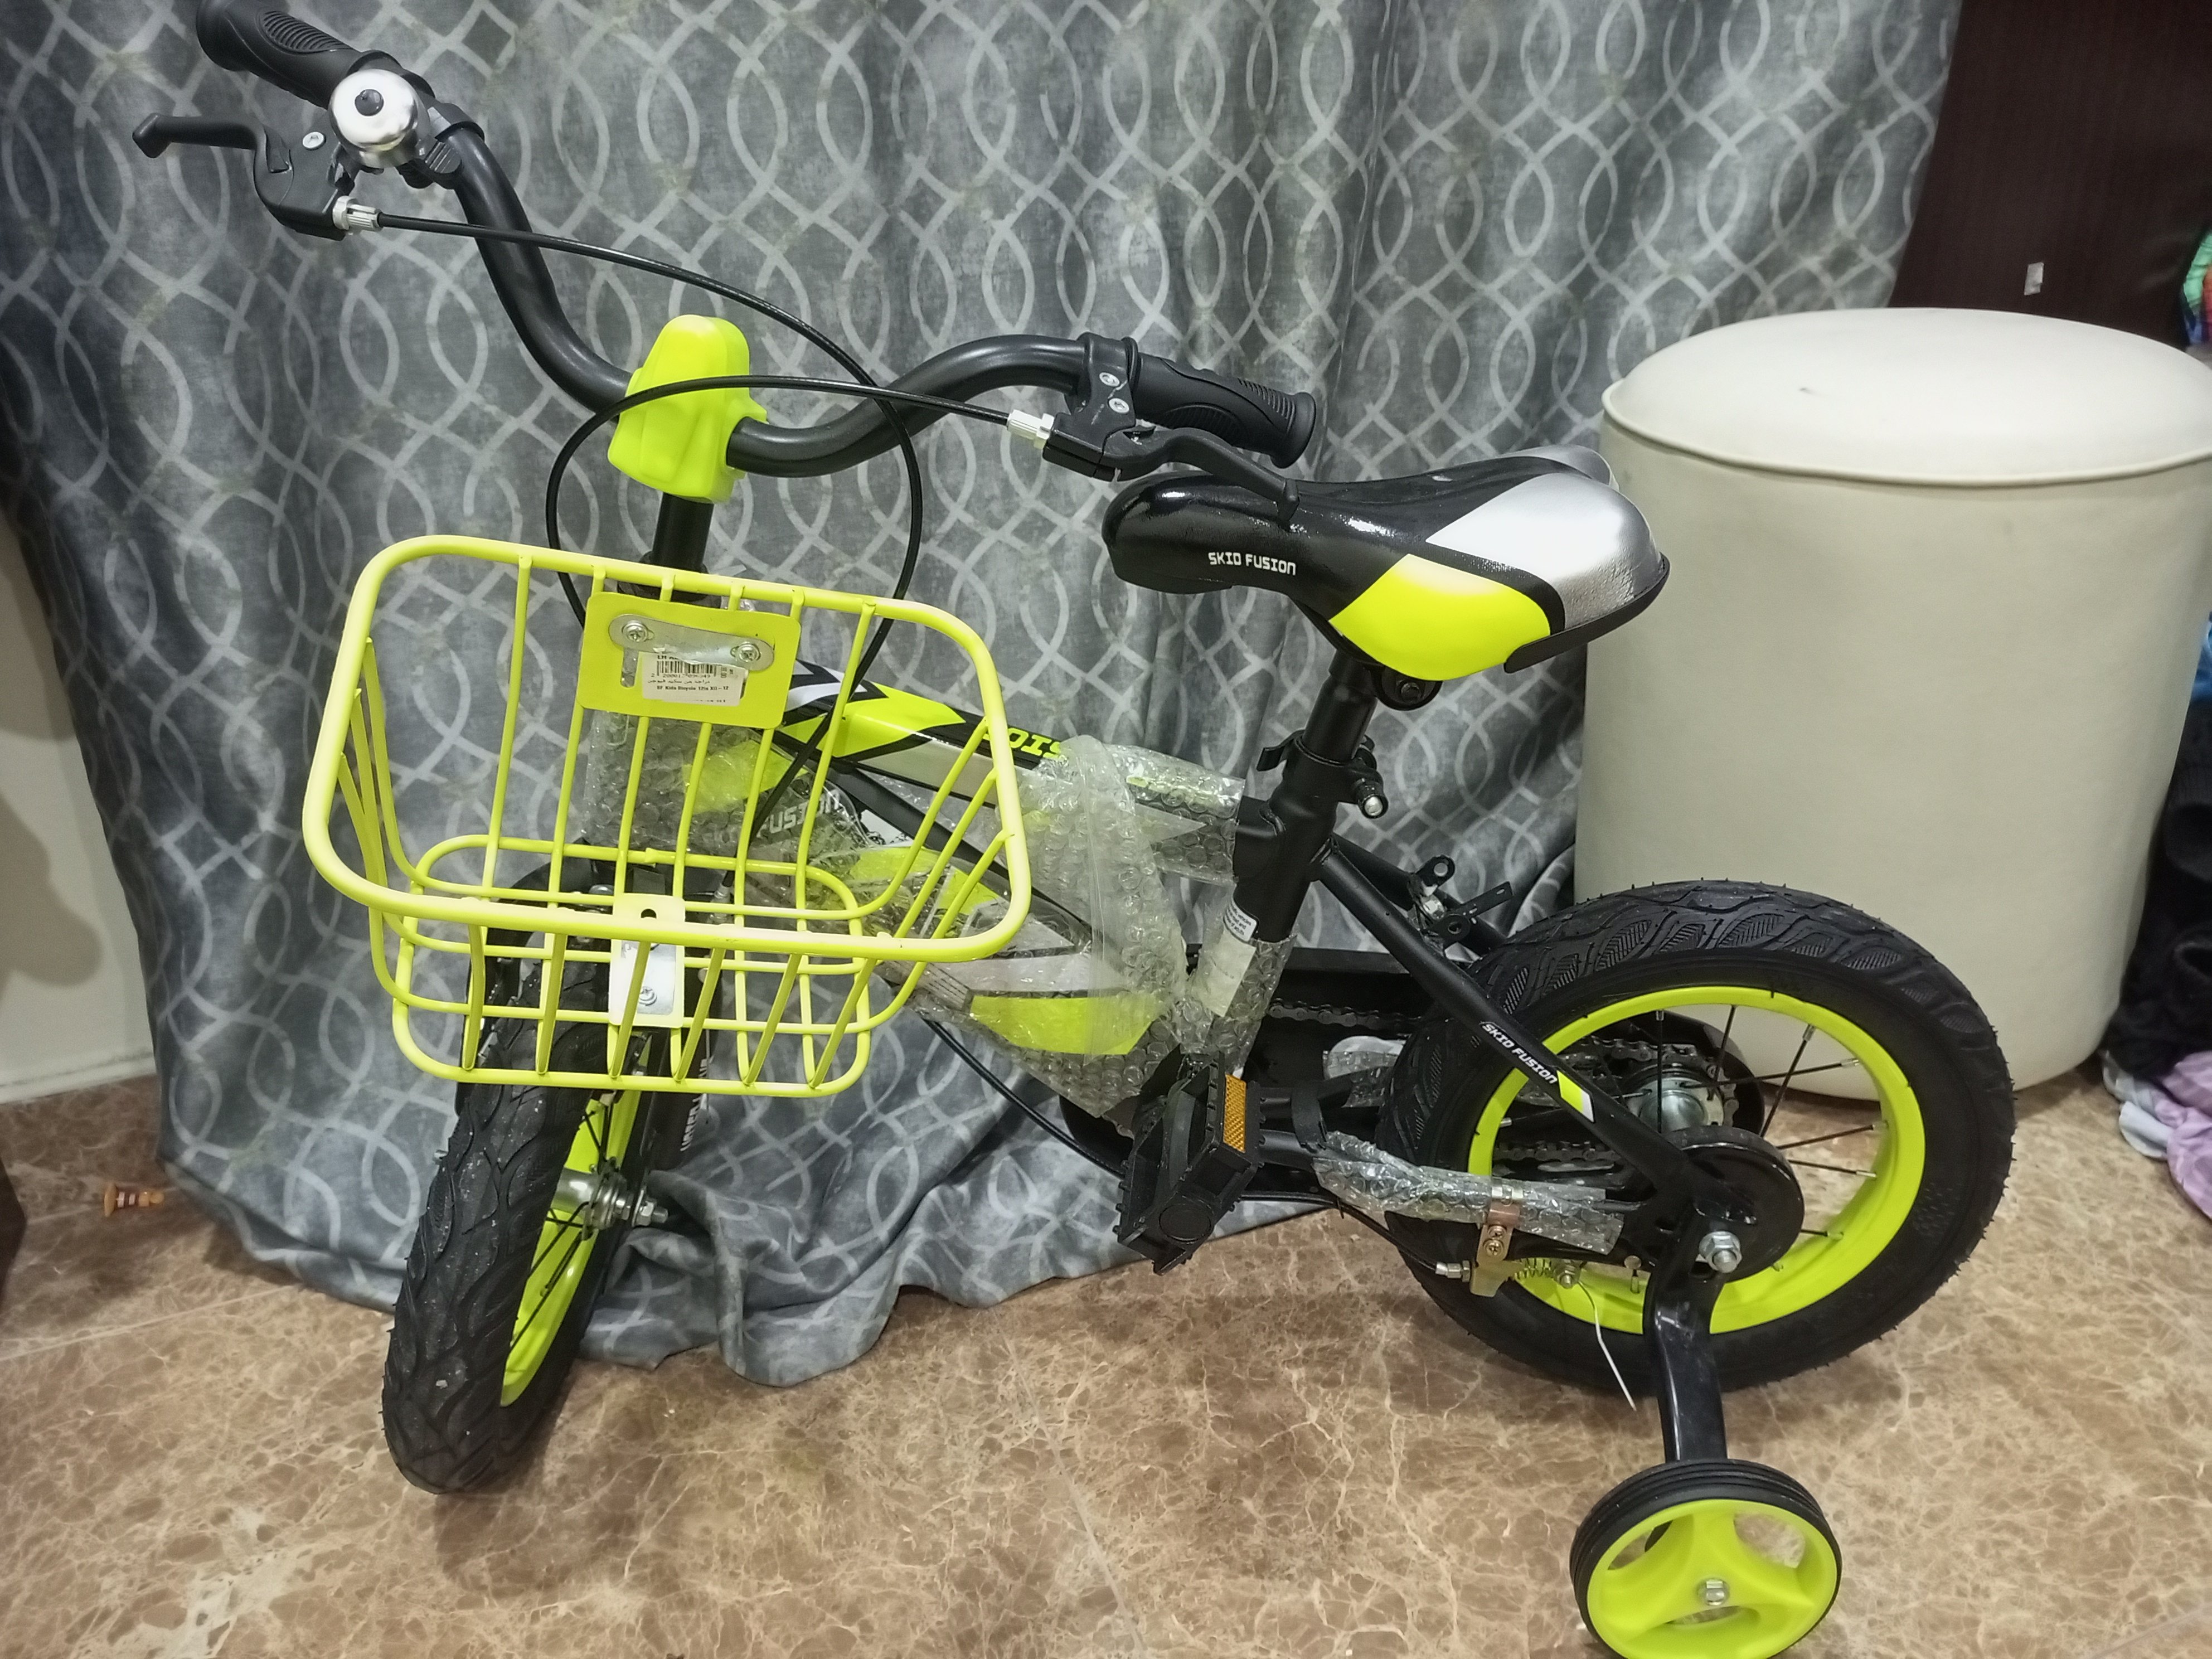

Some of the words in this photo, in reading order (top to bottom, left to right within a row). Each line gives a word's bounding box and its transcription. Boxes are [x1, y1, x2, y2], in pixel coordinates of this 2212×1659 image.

[1208, 552, 1241, 565] SKID
[1245, 553, 1296, 576] FUSION
[1482, 1023, 1515, 1049] SKID
[1511, 1047, 1558, 1084] FUSION
